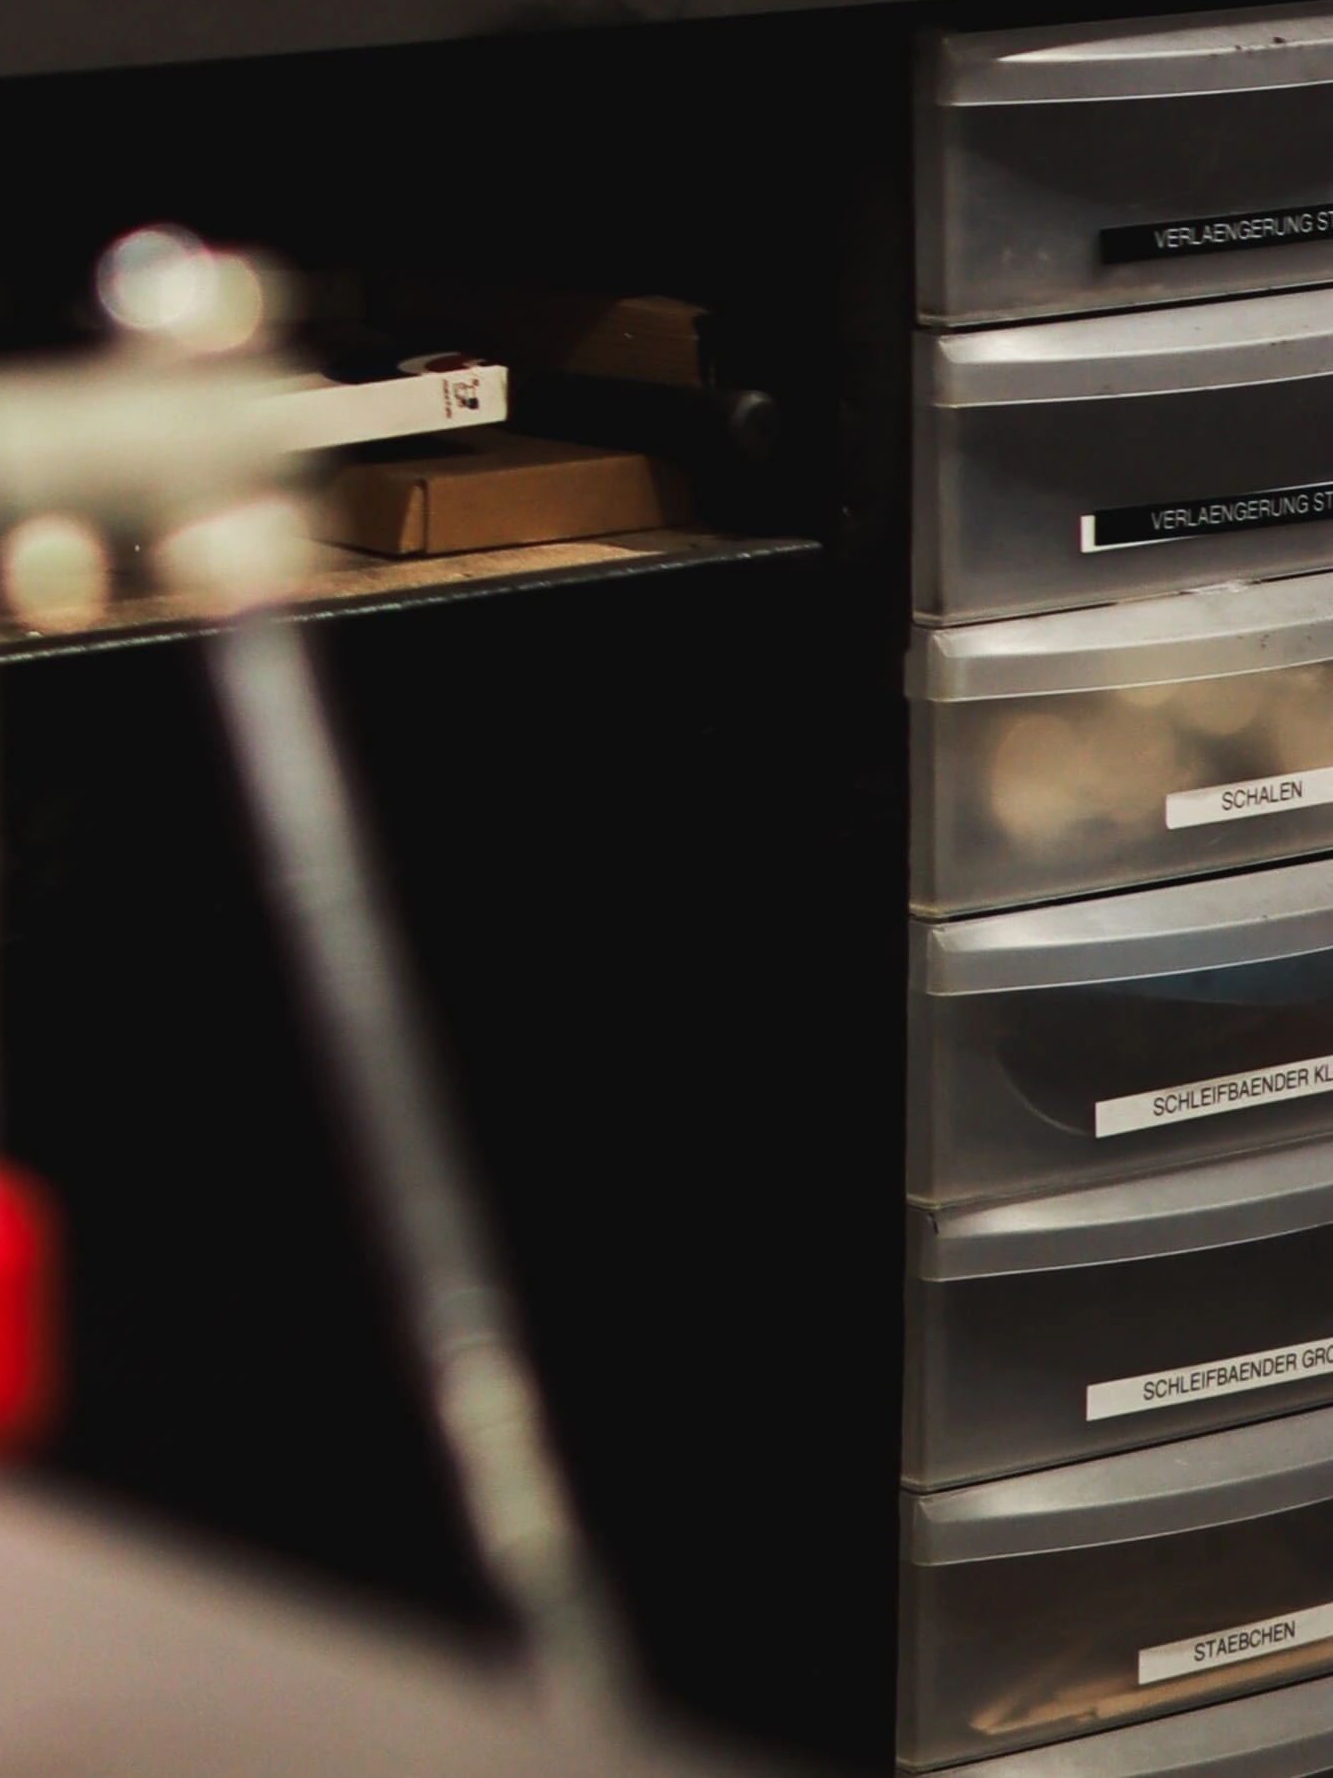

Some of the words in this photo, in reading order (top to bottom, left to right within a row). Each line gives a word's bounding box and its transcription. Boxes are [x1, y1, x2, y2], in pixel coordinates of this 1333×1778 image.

[1153, 213, 1314, 249] VERLAENGERUNG
[1151, 494, 1310, 530] VERLAENGERUNG
[1221, 780, 1303, 811] SCHALEN
[1152, 1068, 1310, 1117] SCHLEIFBAENDER
[1142, 1352, 1298, 1401] SCHLEIFBAENDER
[1193, 1620, 1296, 1662] STAEBCHEN
